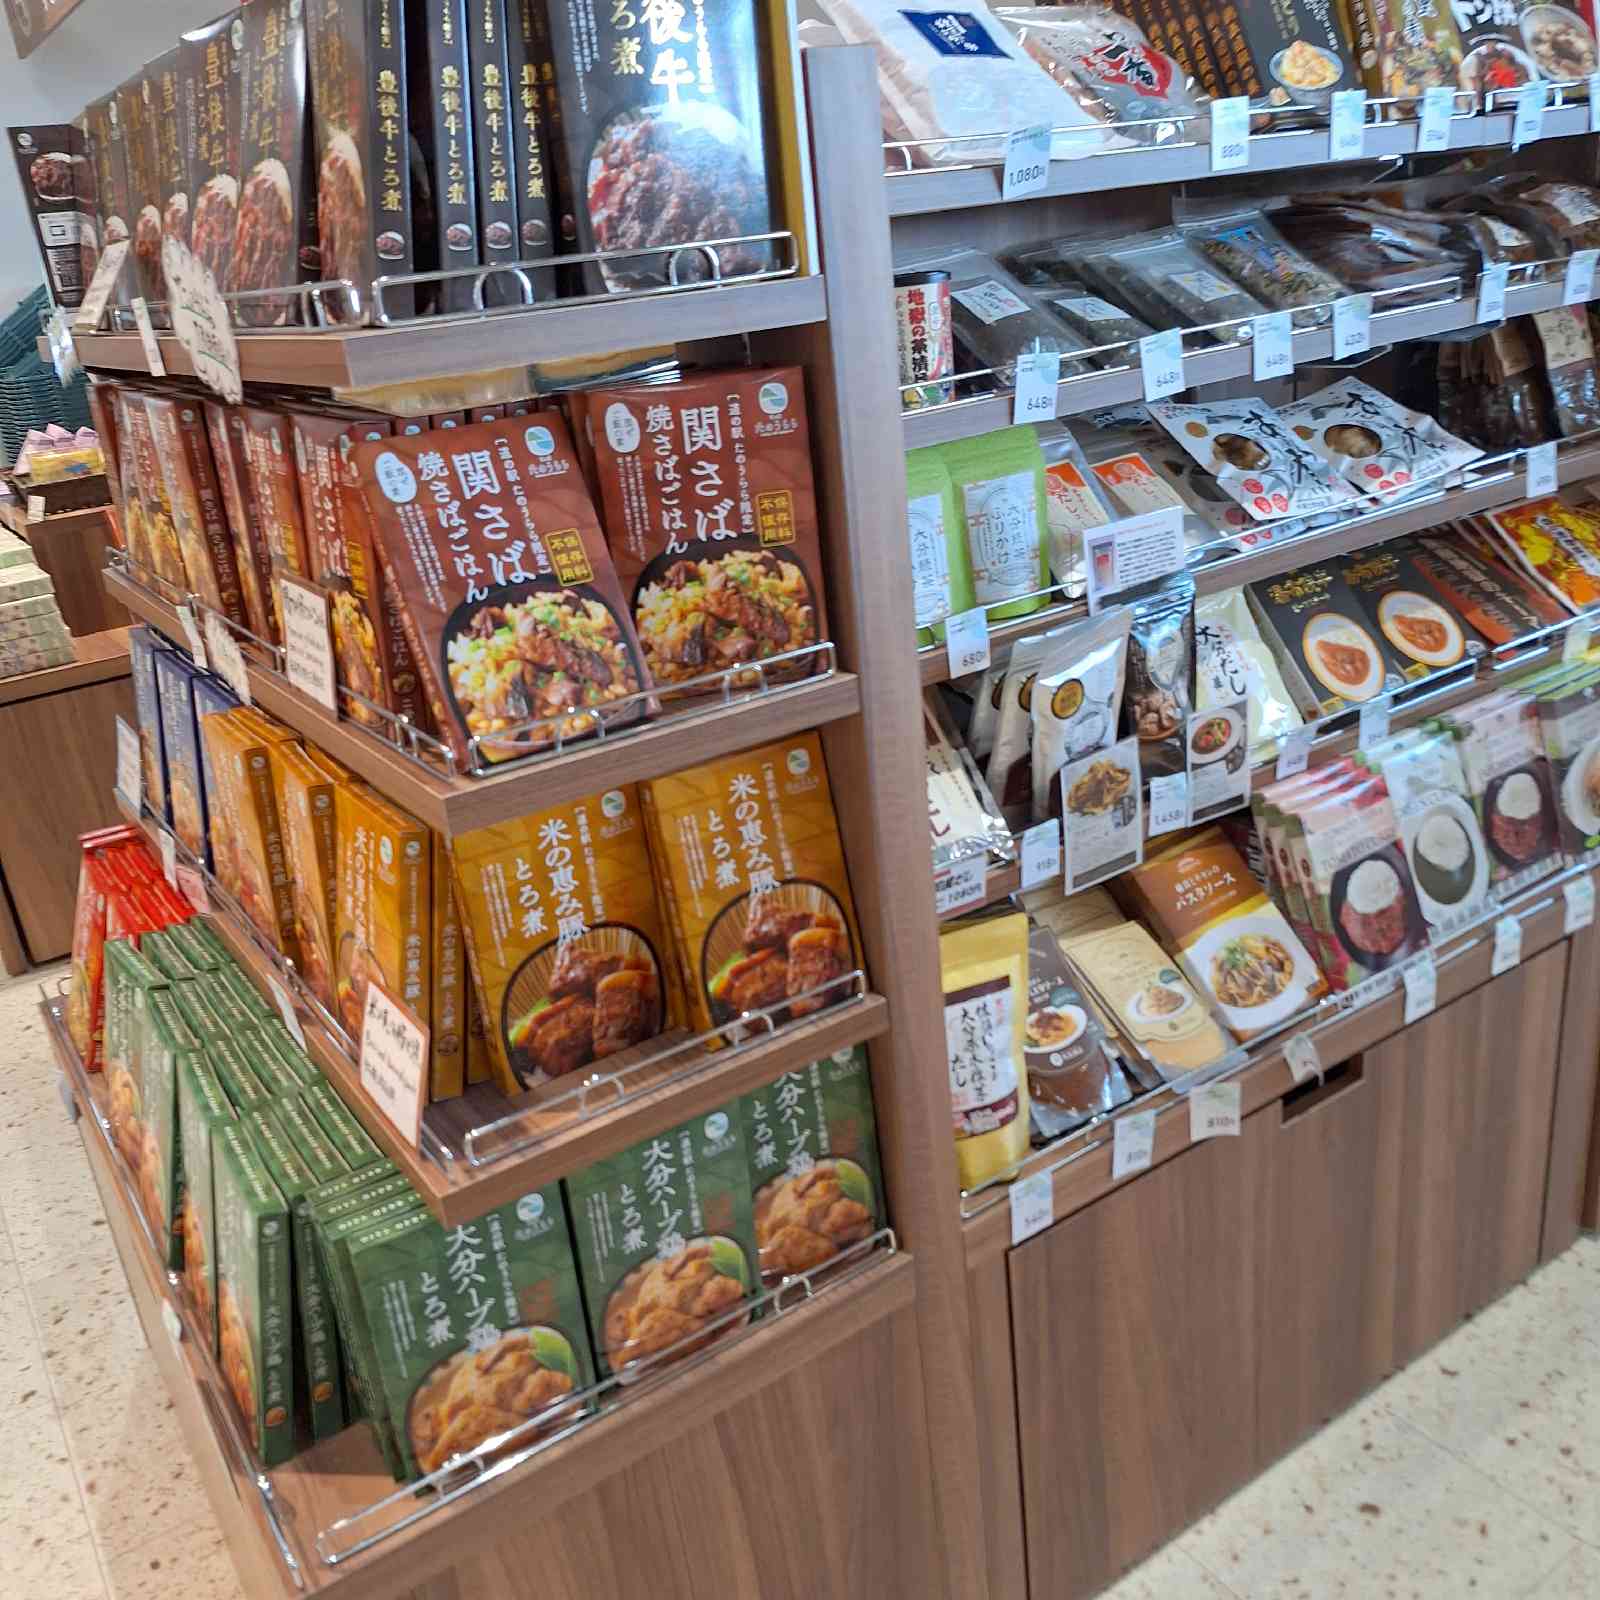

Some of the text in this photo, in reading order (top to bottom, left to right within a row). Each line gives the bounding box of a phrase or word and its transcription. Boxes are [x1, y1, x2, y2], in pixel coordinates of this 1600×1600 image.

[645, 403, 688, 556] 焼さばごはん
[679, 405, 738, 542] 関さば
[417, 450, 489, 604] 焼さばごはん
[452, 449, 537, 587] 関さば
[708, 808, 741, 891] とろ煮
[515, 857, 550, 939] とろ煮
[752, 1099, 780, 1170] とろ煮
[618, 1182, 649, 1255] とろ煮
[419, 1270, 456, 1349] とろ煮
